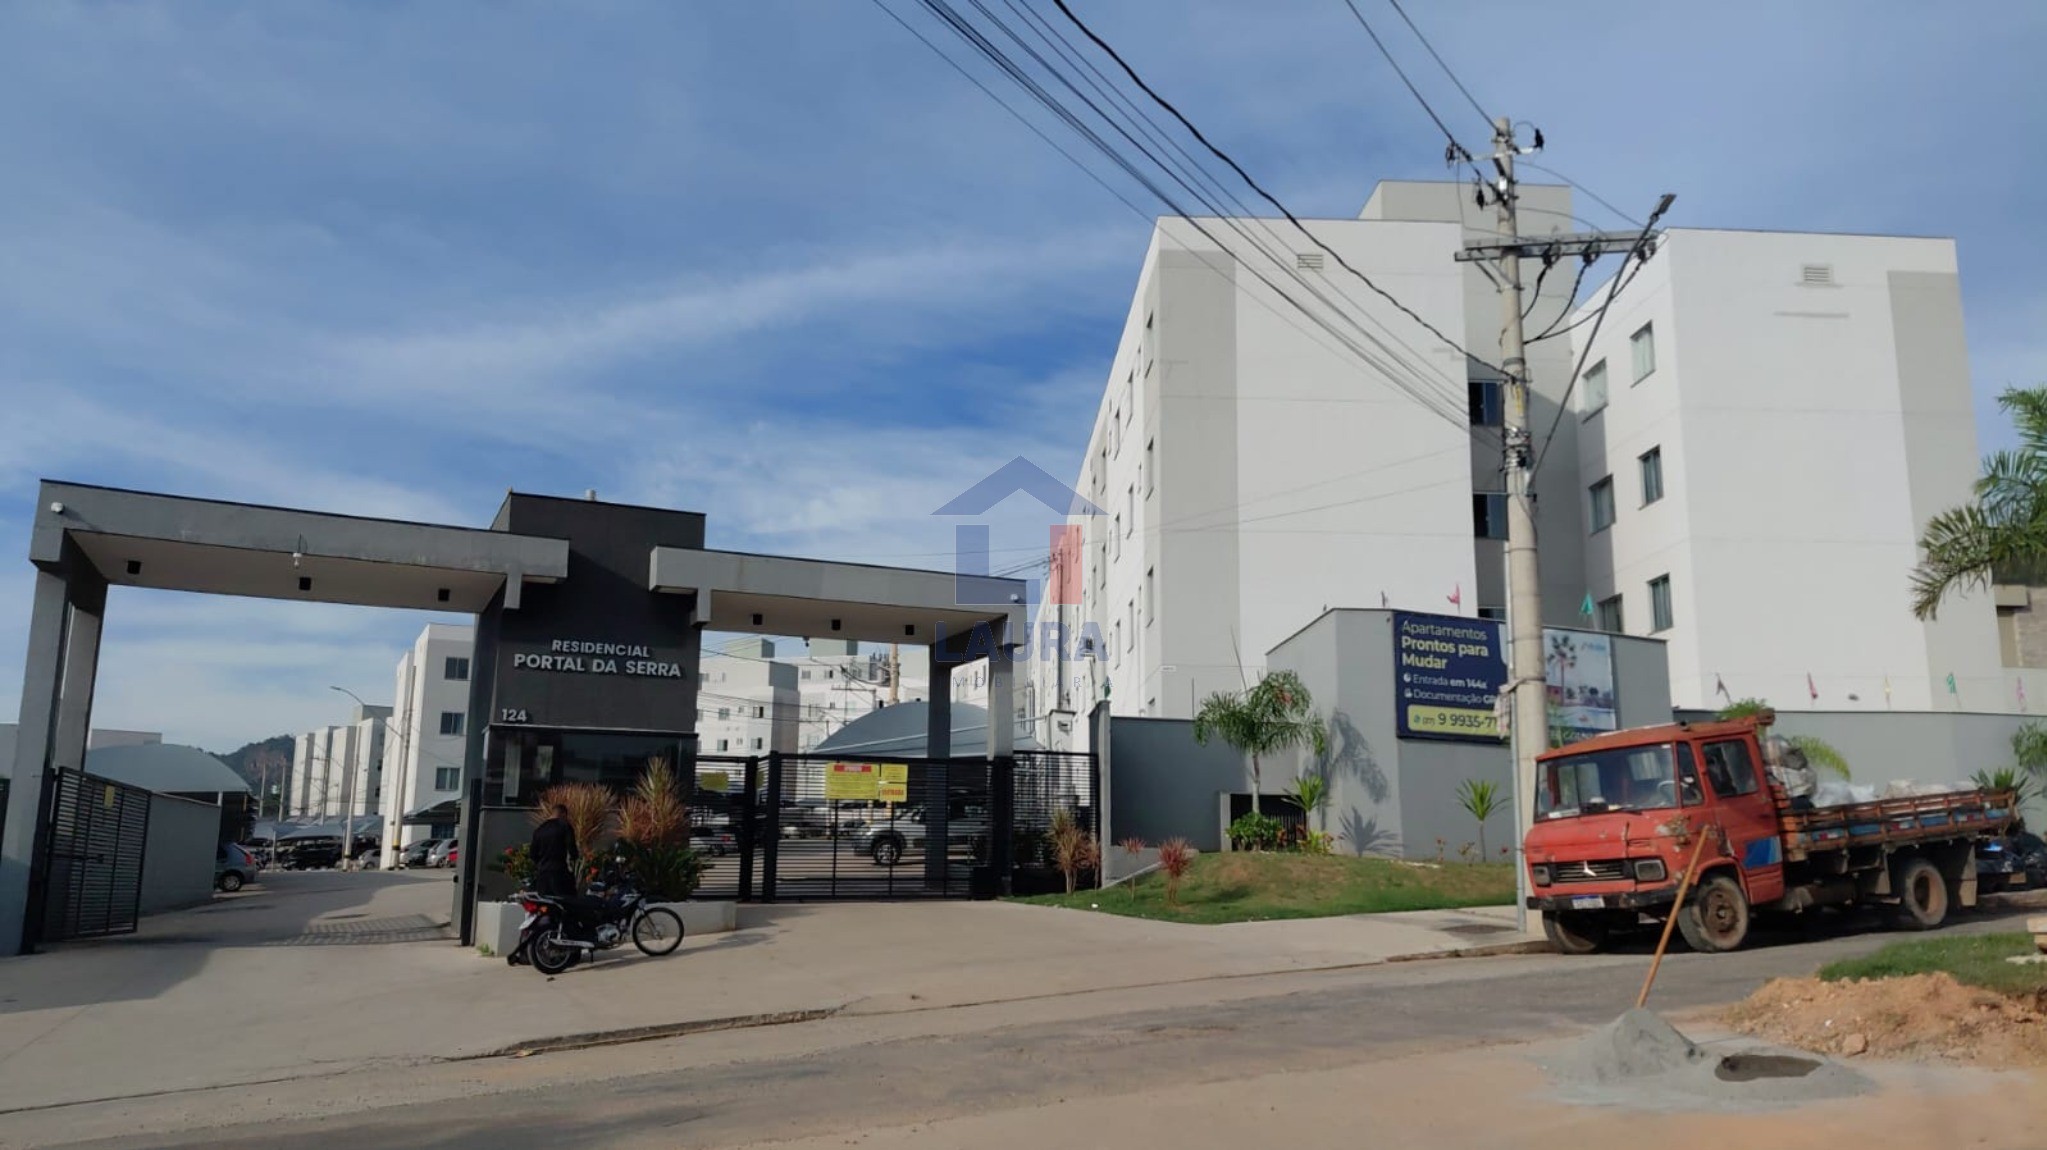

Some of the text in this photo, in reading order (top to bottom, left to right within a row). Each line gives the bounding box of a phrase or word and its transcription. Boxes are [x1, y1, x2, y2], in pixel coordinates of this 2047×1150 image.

[1402, 620, 1487, 640] Apartamentos
[551, 639, 650, 657] RESIDENCIAL
[1401, 636, 1489, 657] Prontos para
[513, 653, 681, 677] PORTAL DA SERRA
[1402, 652, 1448, 669] Mudar
[1413, 674, 1448, 686] Entrada
[1450, 679, 1465, 688] em
[1413, 689, 1482, 704] Documentação
[501, 708, 527, 722] 124
[1437, 712, 1446, 725] 9
